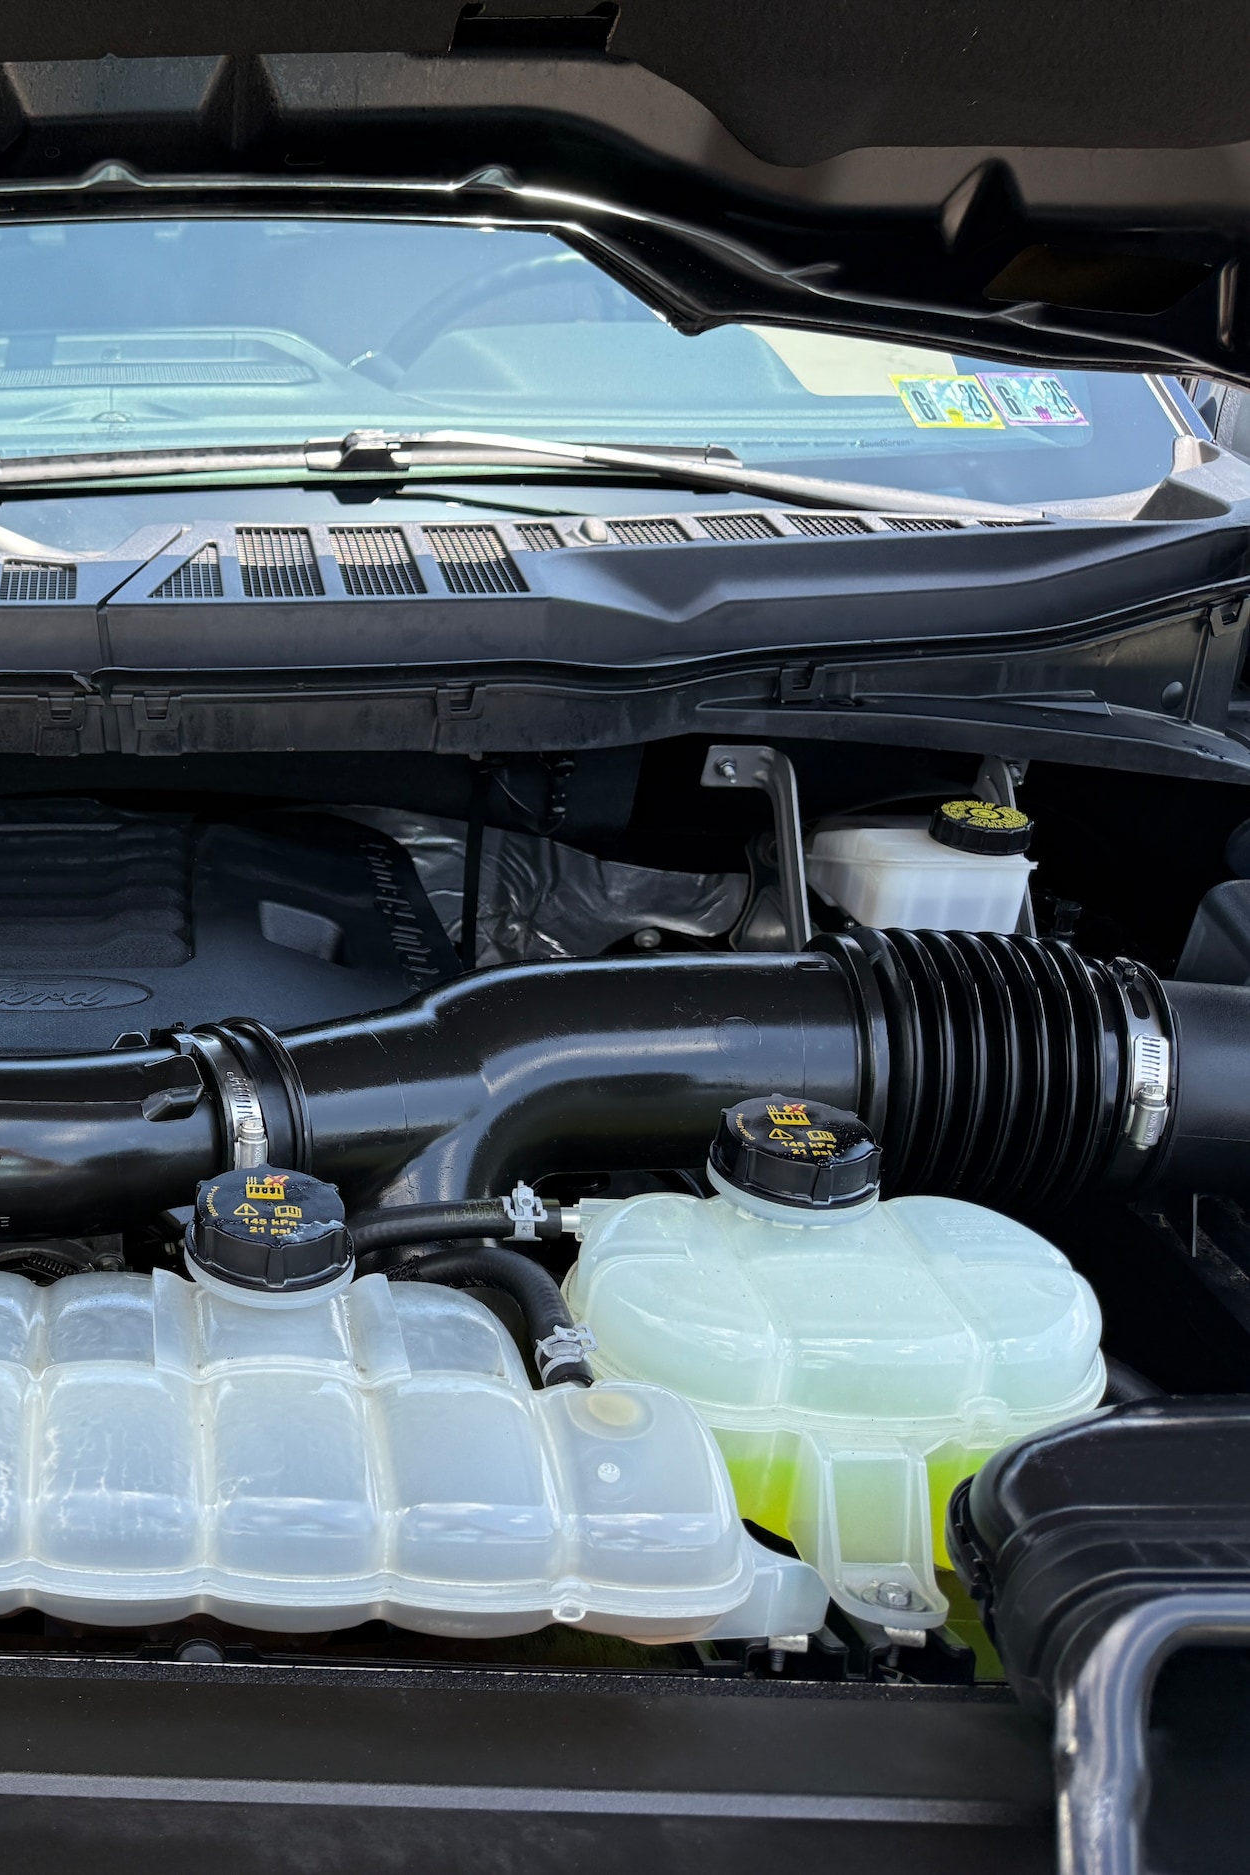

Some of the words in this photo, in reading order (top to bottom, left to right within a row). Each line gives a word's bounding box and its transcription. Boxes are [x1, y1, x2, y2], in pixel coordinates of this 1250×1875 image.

[910, 389, 938, 421] 6
[958, 383, 994, 418] 26
[995, 385, 1023, 416] 6
[1040, 380, 1078, 415] 26
[808, 1141, 837, 1149] kPa
[812, 1149, 832, 1157] psi
[242, 1217, 267, 1226] 145
[271, 1218, 297, 1227] kPa
[249, 1226, 265, 1234] 21
[270, 1227, 291, 1236] psi
